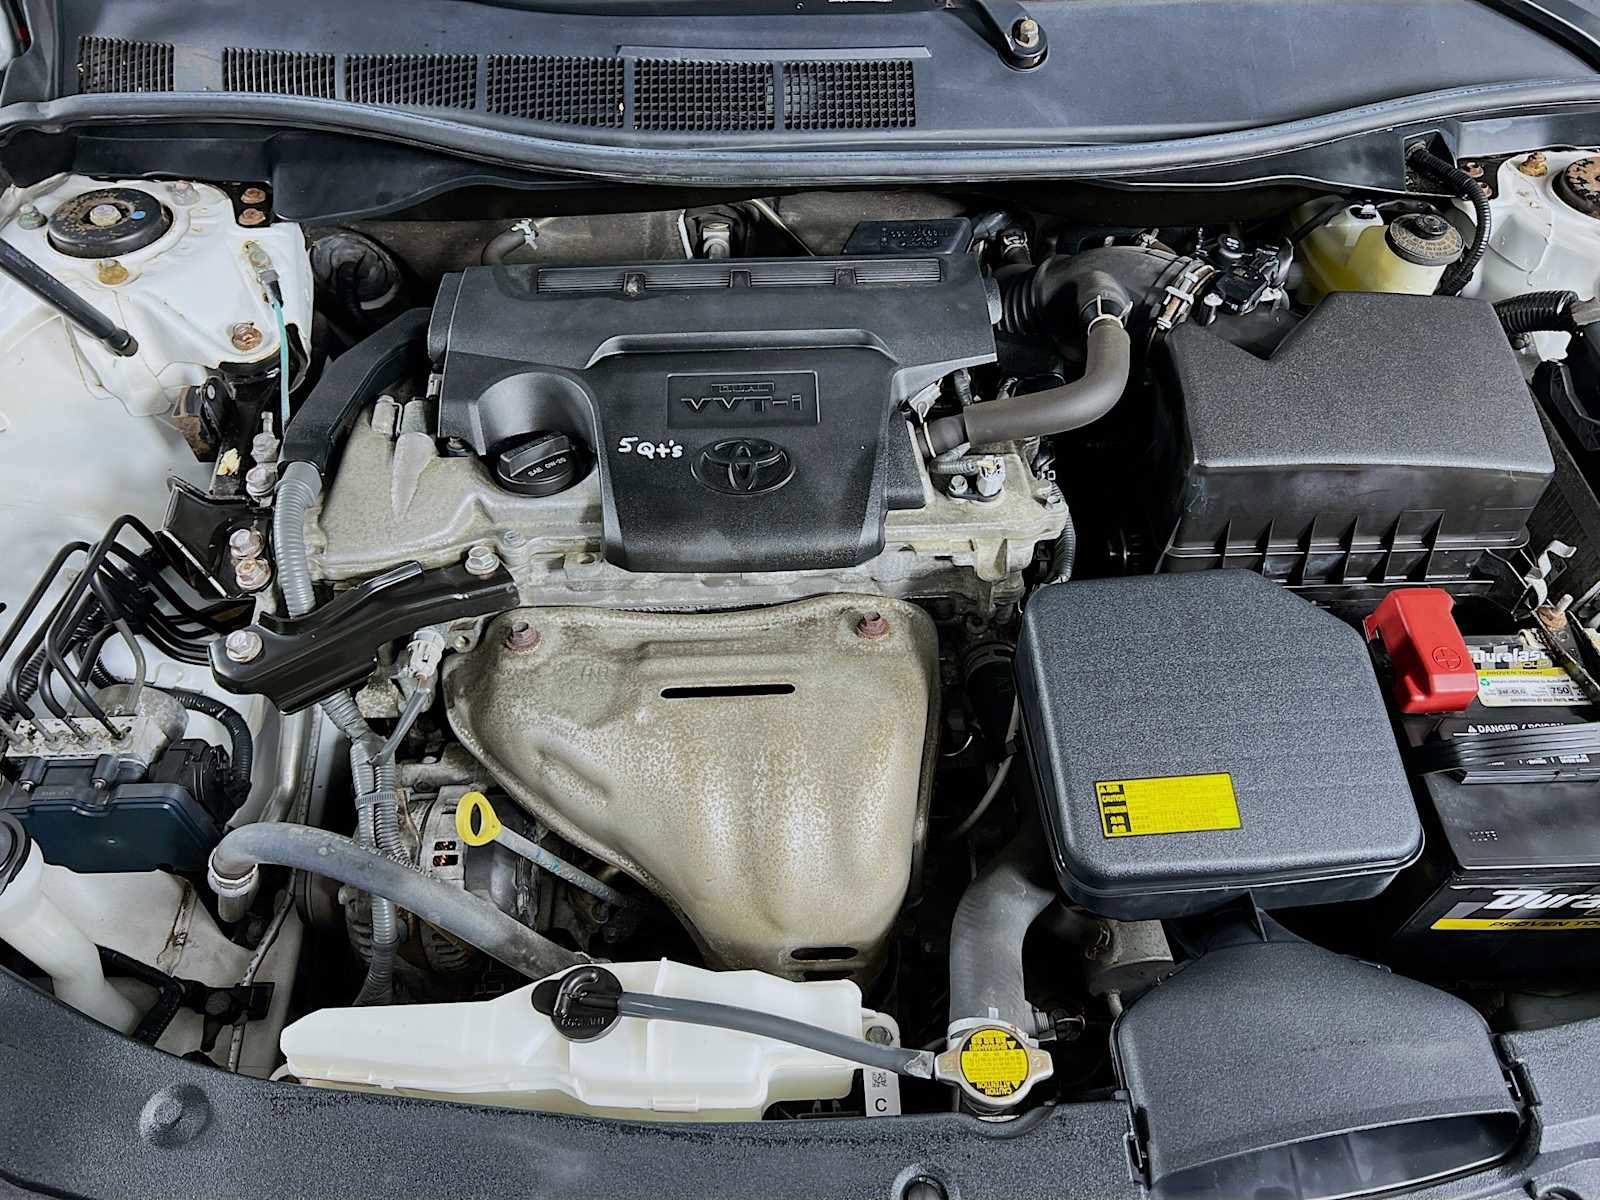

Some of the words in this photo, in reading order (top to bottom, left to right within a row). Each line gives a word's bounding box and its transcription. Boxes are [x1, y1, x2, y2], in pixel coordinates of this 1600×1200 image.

[681, 395, 802, 414] VVT-i
[527, 466, 544, 477] SAE
[1550, 686, 1569, 694] 750
[1477, 724, 1518, 734] DANGER
[984, 1087, 1012, 1096] CAUTION
[875, 1097, 887, 1112] C
